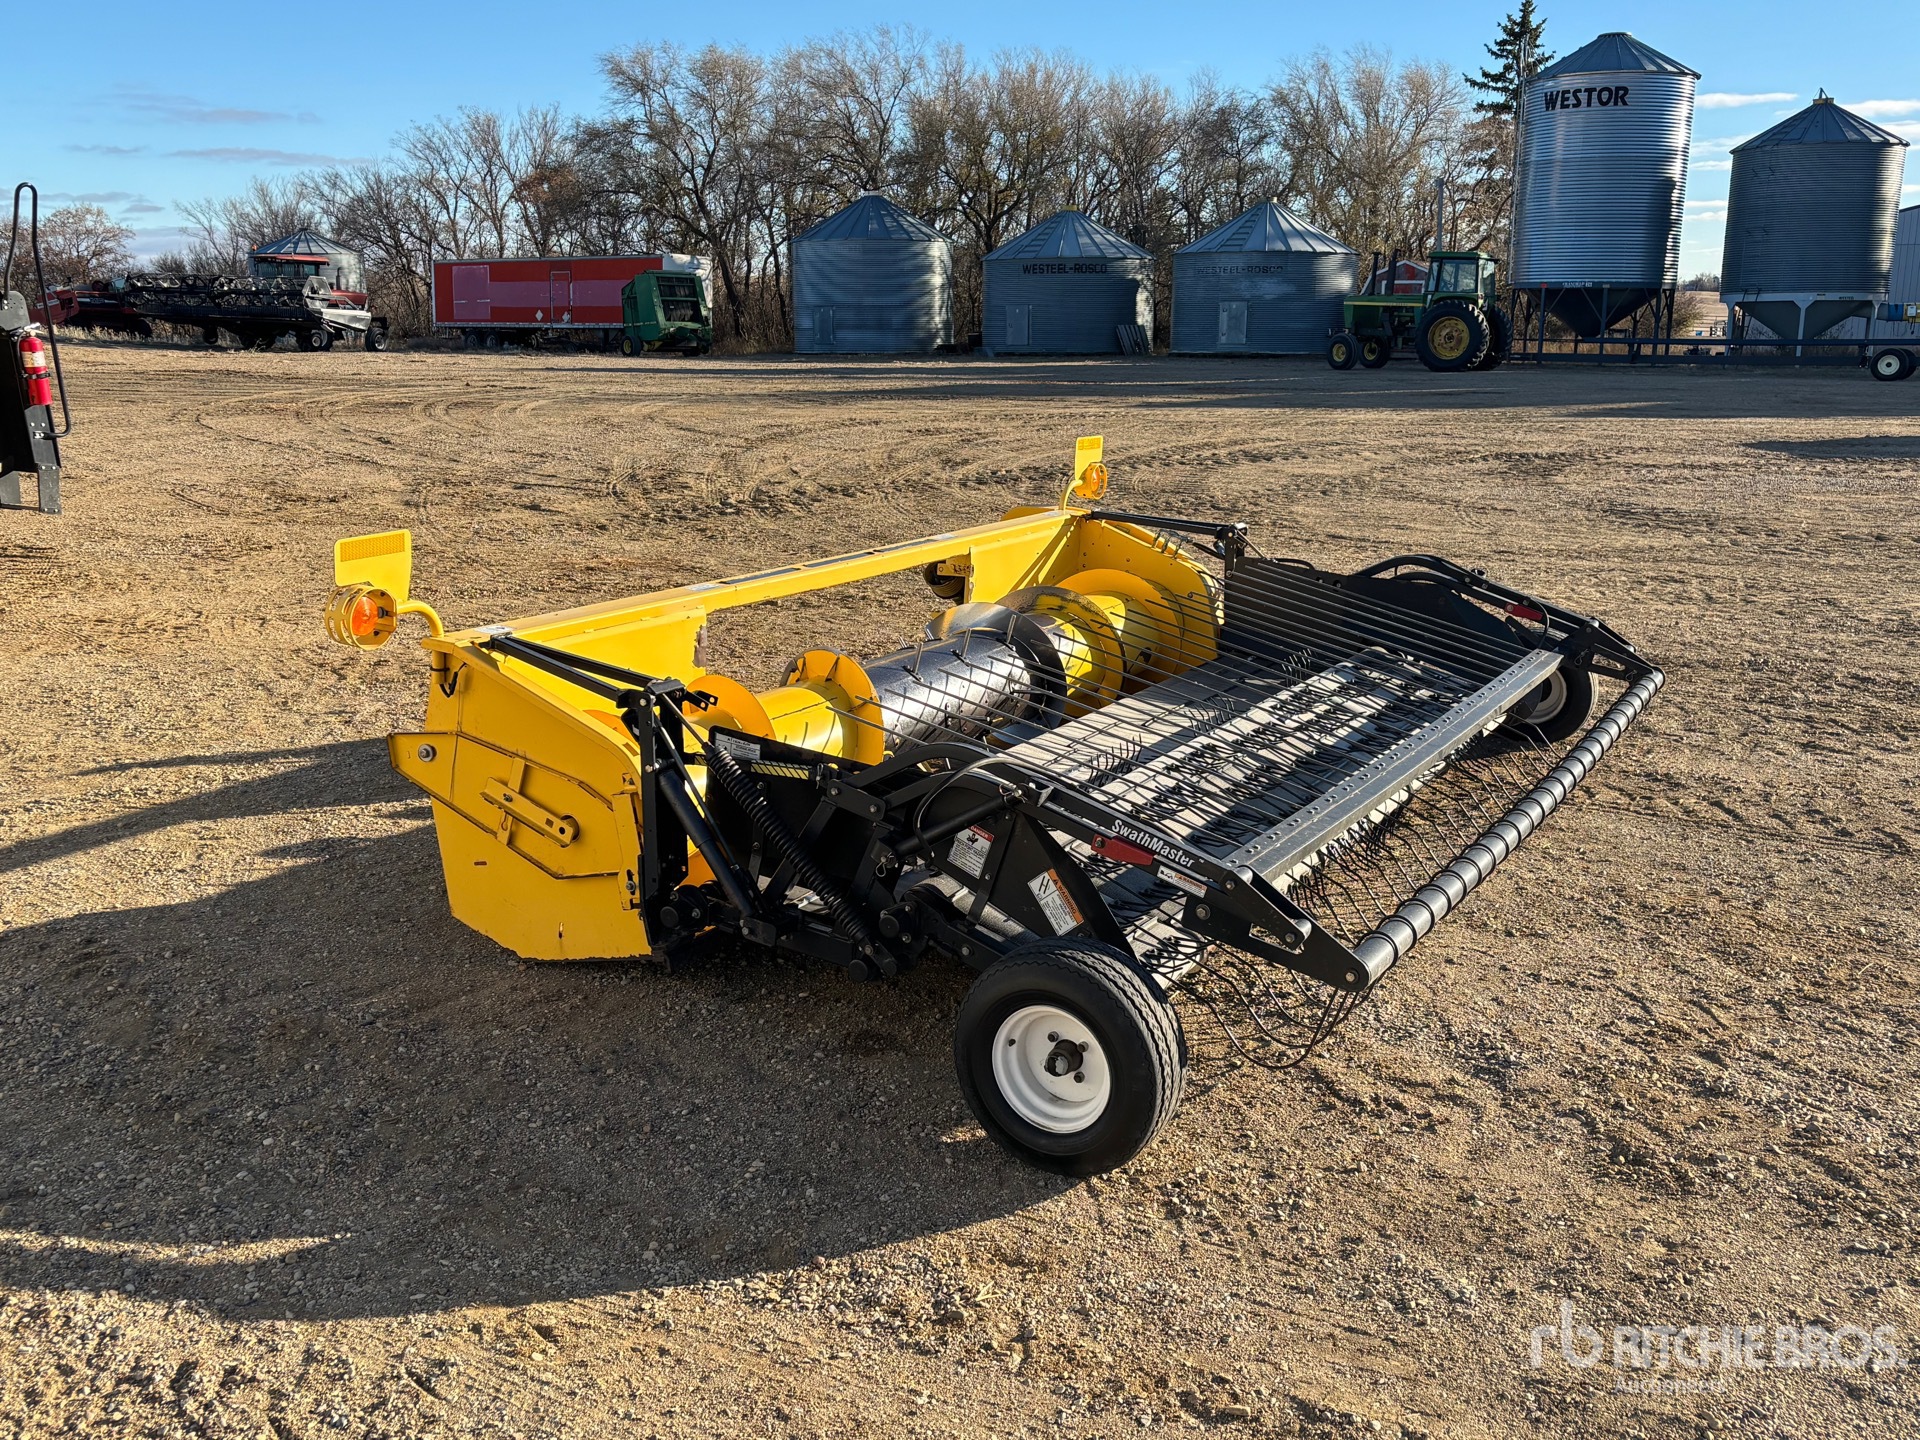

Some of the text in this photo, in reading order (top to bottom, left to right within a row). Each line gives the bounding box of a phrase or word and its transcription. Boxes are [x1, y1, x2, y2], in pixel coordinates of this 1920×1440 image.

[1544, 86, 1630, 111] WESTOR
[1022, 263, 1107, 274] WESTEEL-ROSCO
[1112, 820, 1195, 867] SwathMaster
